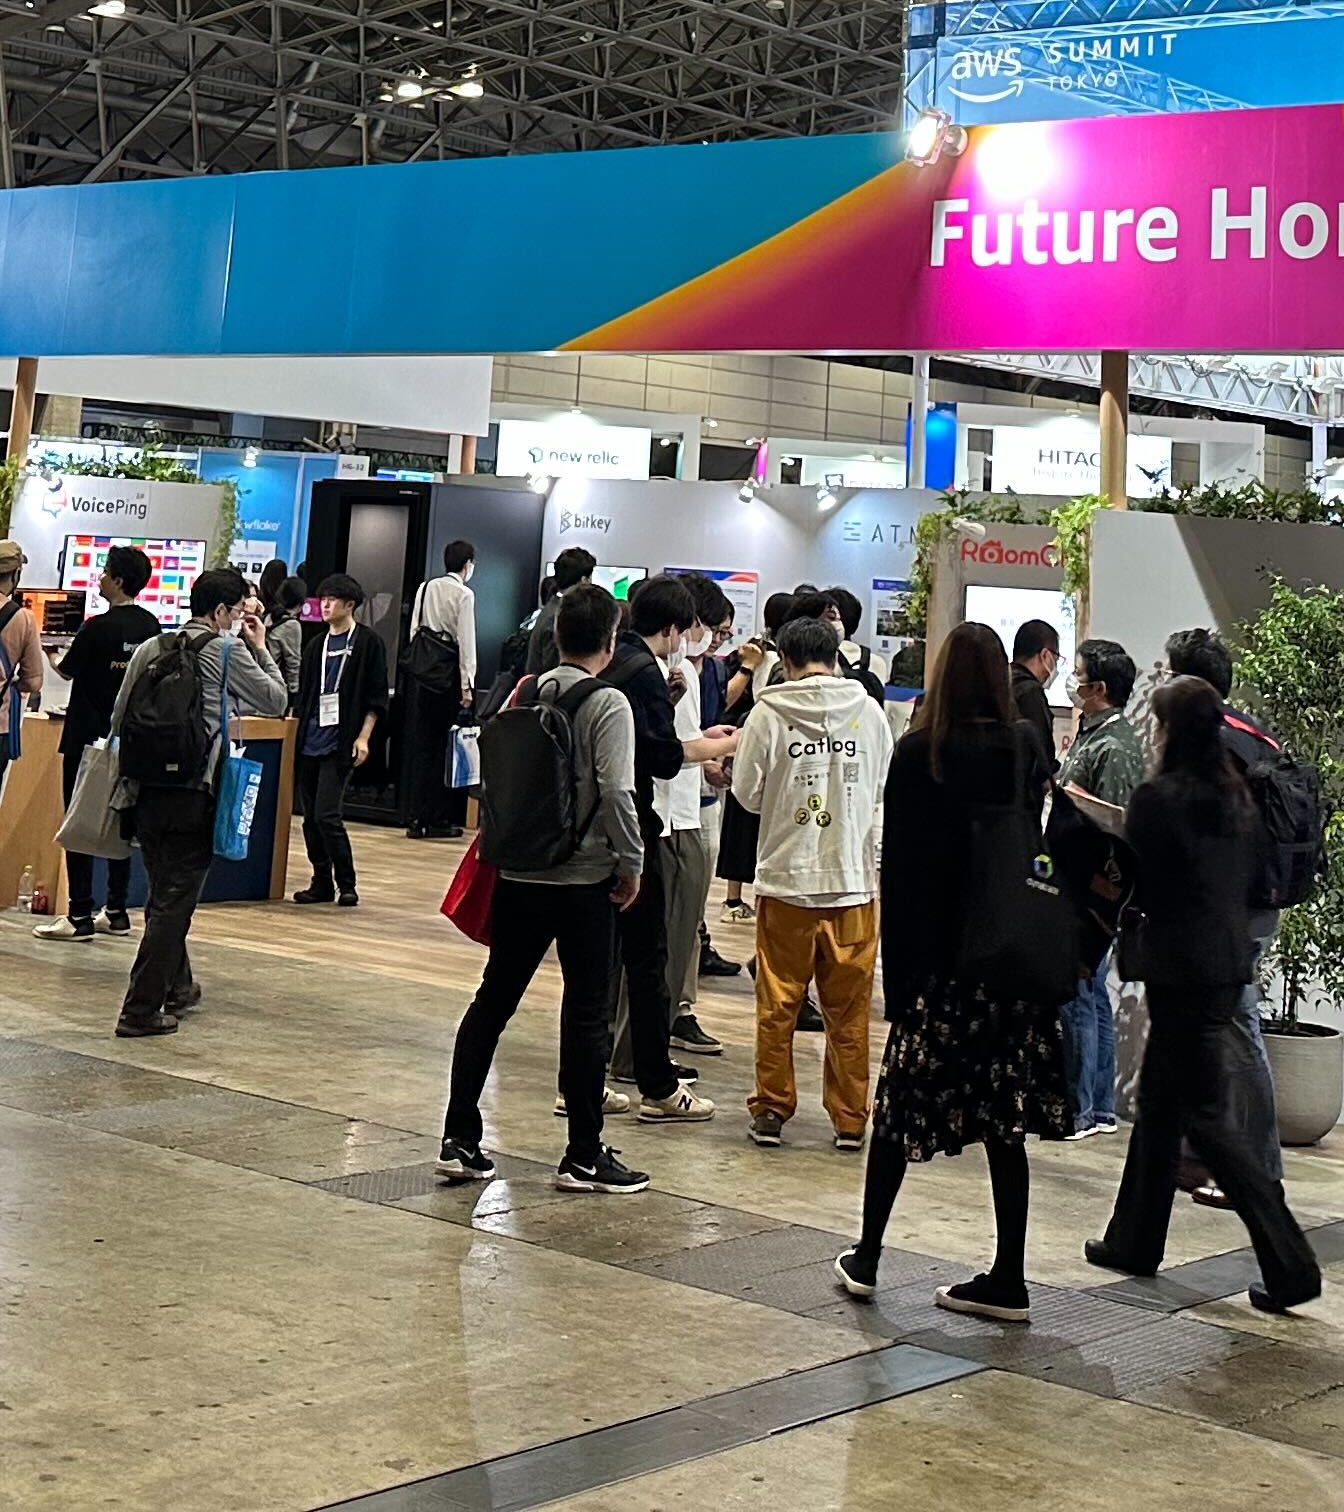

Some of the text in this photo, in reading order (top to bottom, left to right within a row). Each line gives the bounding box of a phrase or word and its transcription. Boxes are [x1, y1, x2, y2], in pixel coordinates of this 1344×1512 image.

[951, 33, 1177, 80] aws SUMMIT
[1048, 71, 1119, 92] TOKYO
[929, 196, 1179, 268] Future
[549, 450, 583, 463] new
[70, 495, 148, 520] VoicePing
[236, 519, 280, 531] wflake
[573, 514, 612, 534] bitkey
[788, 735, 857, 758] Catlog
